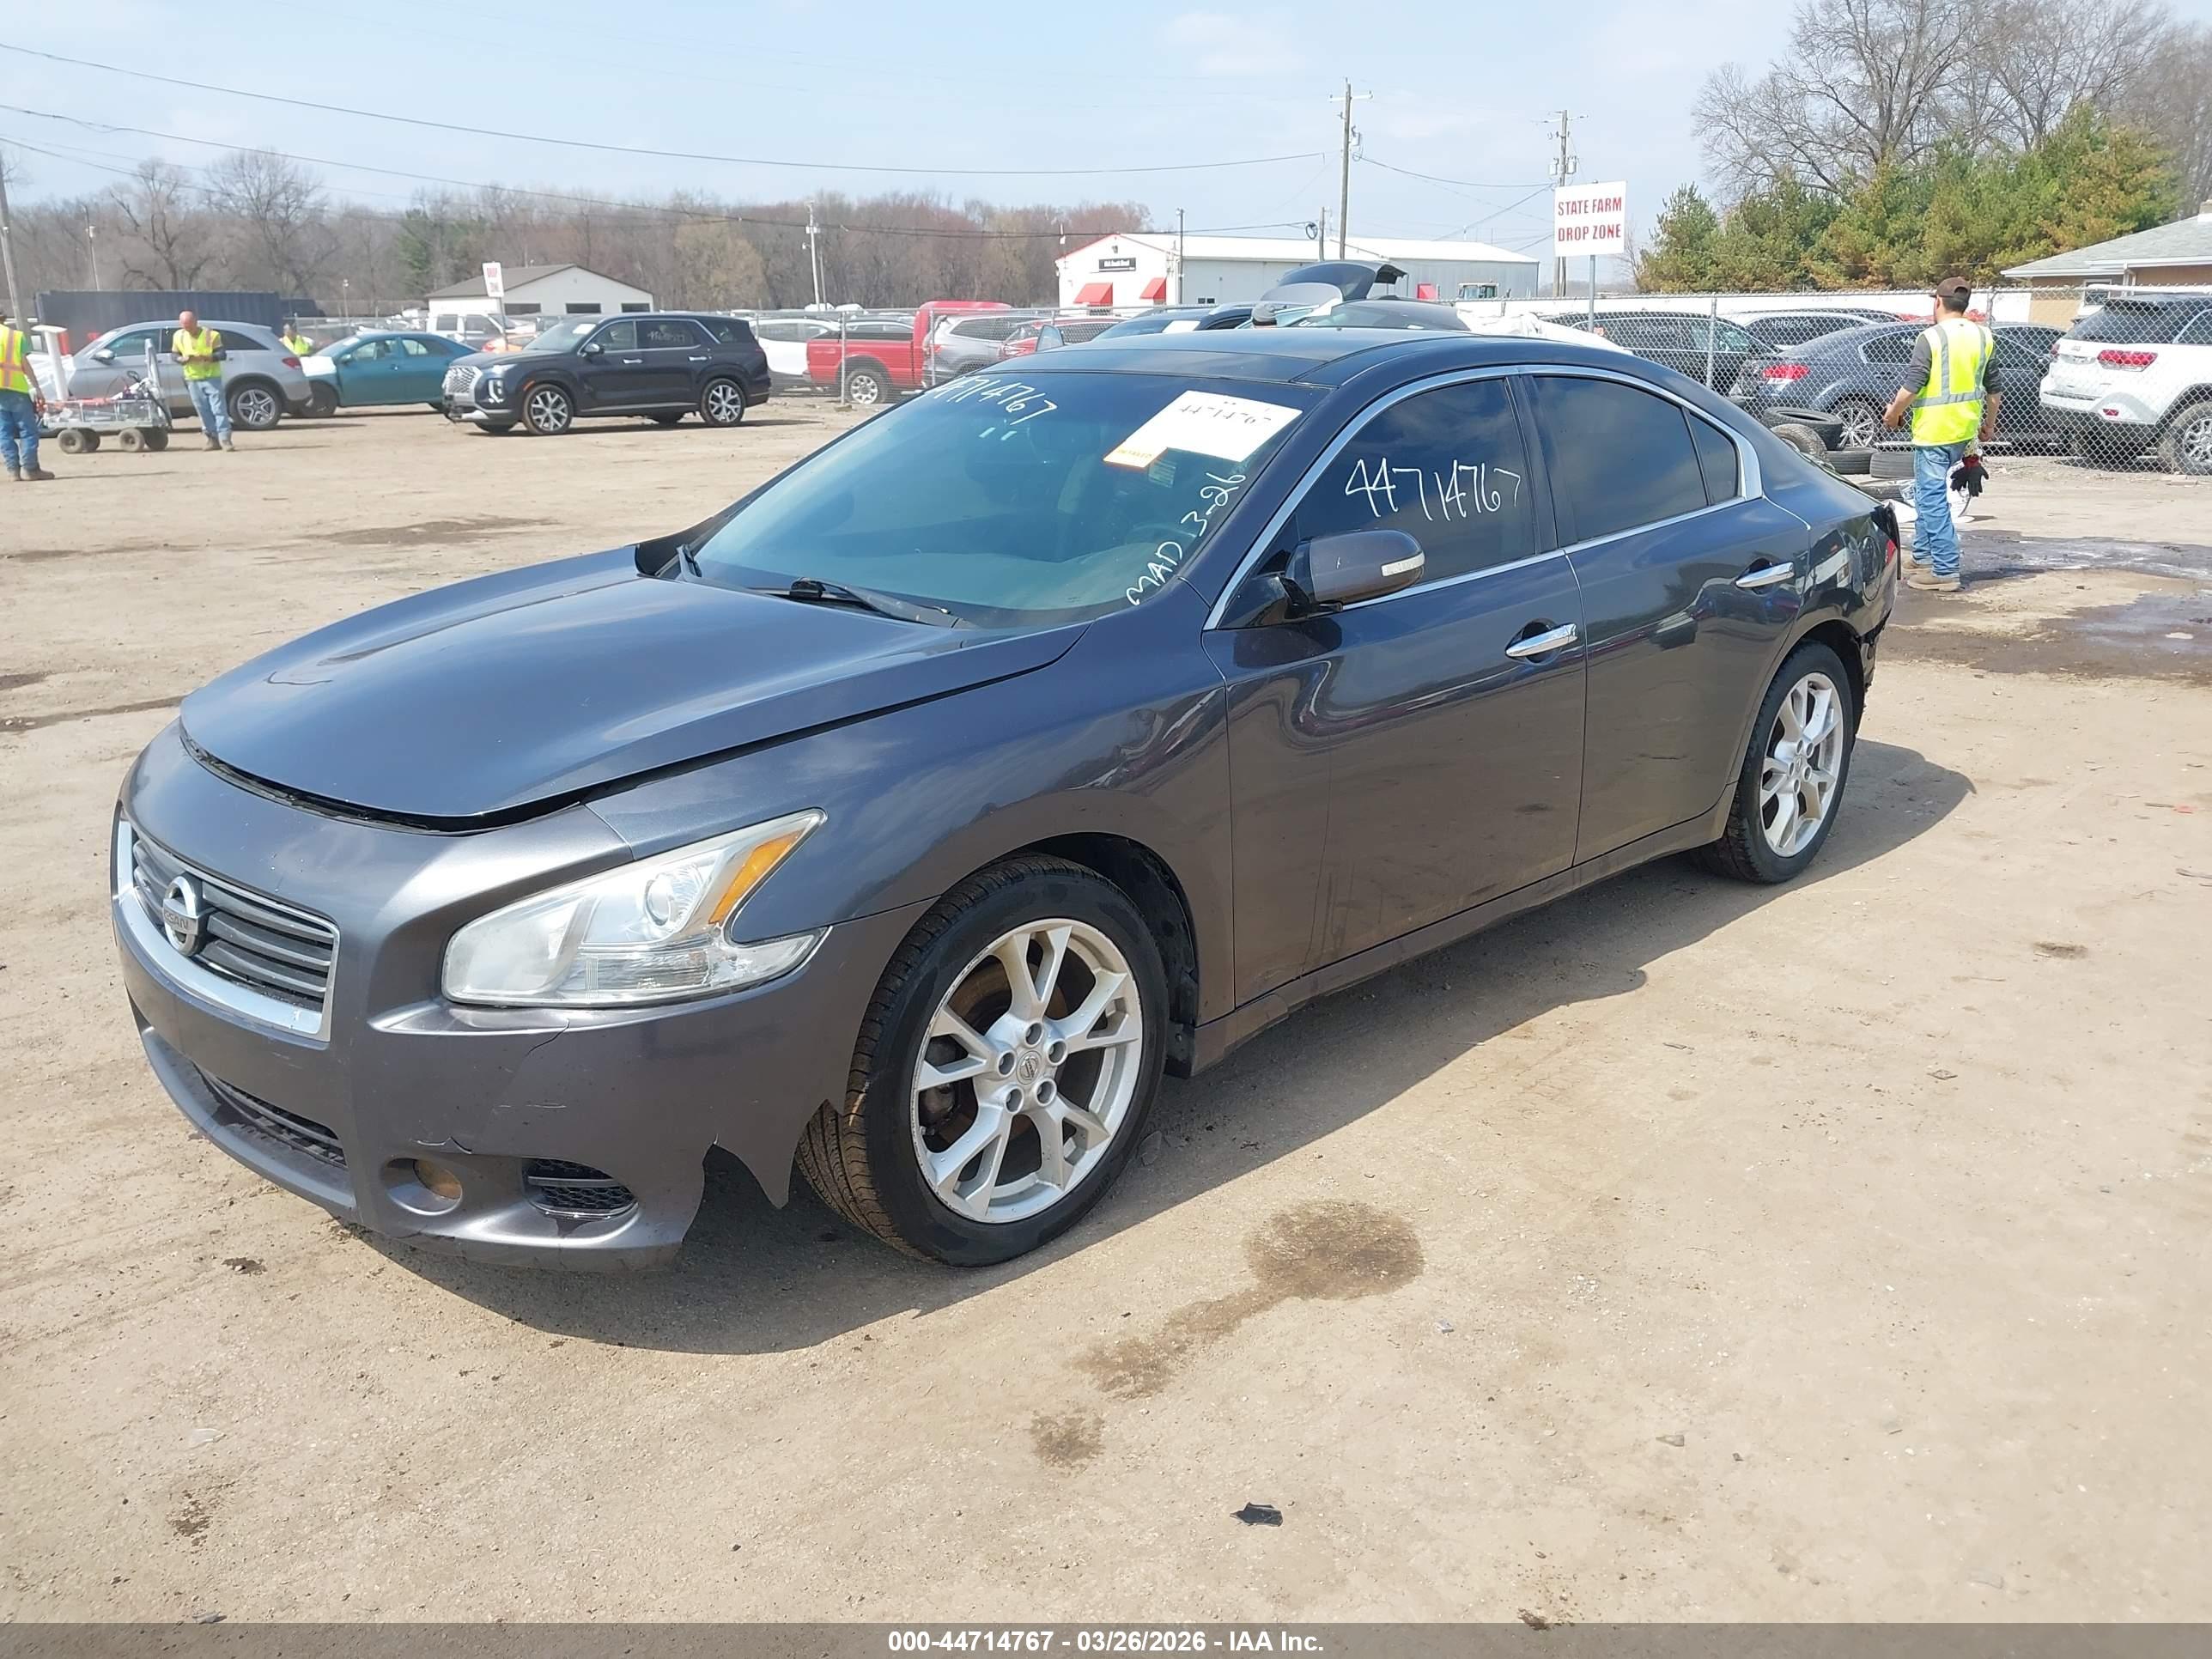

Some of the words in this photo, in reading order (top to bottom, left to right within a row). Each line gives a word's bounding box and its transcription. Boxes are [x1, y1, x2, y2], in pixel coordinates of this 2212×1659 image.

[1558, 199, 1589, 216] STATE
[1592, 197, 1622, 214] FARM
[1558, 226, 1589, 242] DROP
[1592, 223, 1621, 240] ZONE
[1345, 457, 1522, 521] 44714767
[1126, 541, 1183, 605] MAD
